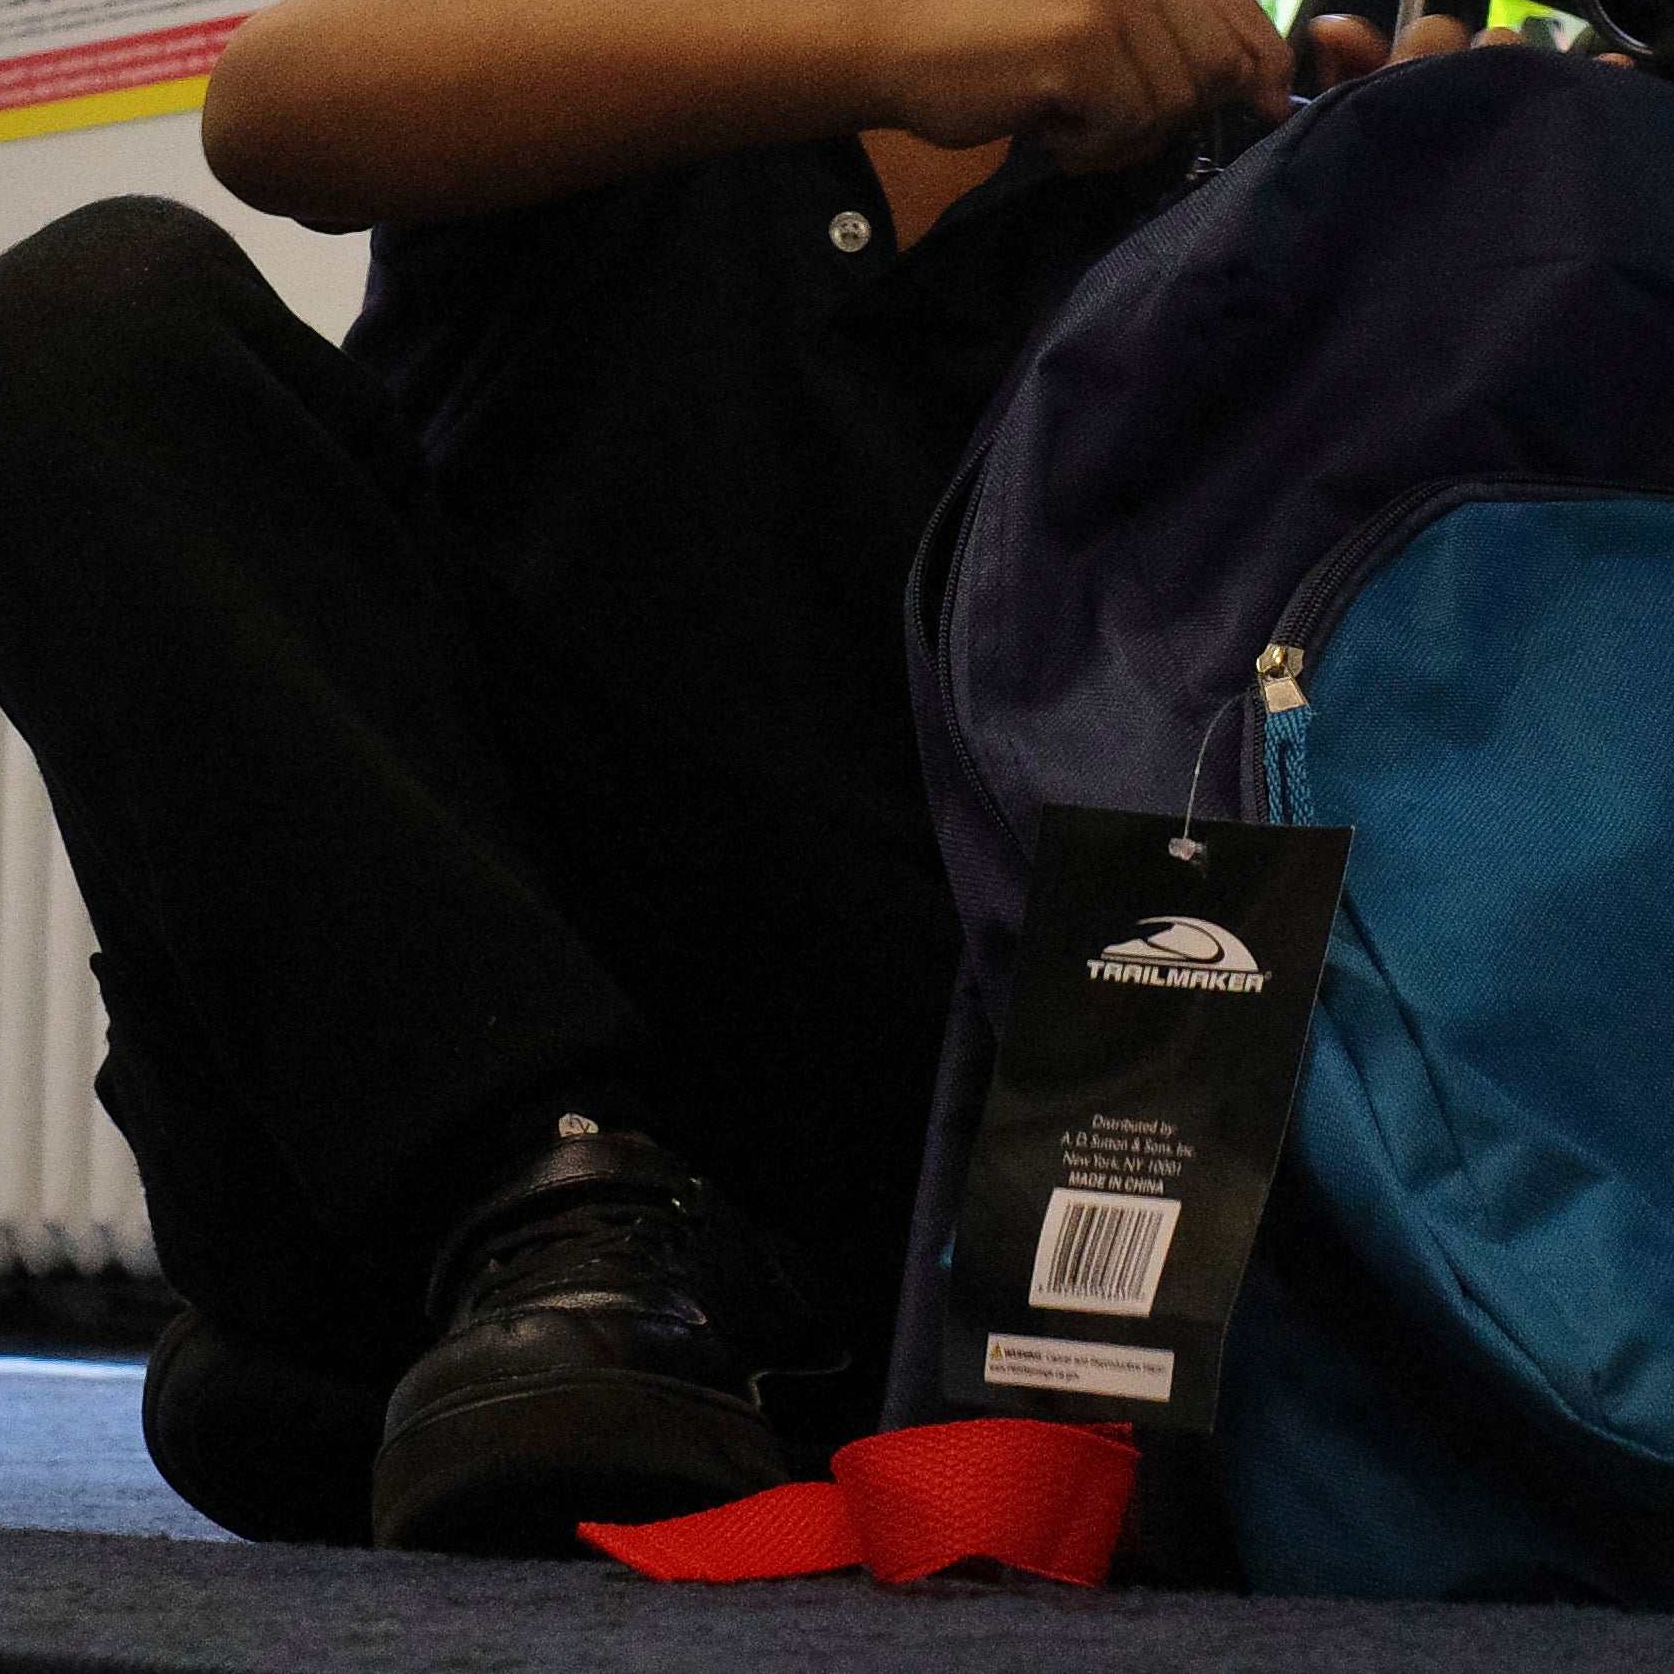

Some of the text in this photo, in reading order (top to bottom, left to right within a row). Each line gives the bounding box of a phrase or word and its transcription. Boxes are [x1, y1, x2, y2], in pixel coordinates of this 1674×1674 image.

[1087, 959, 1265, 993] TRAILMAKER
[1091, 1113, 1158, 1134] Distributed
[1130, 1136, 1141, 1154] &
[1062, 1150, 1091, 1168] New
[1068, 1170, 1165, 1196] MADE IN CHINA
